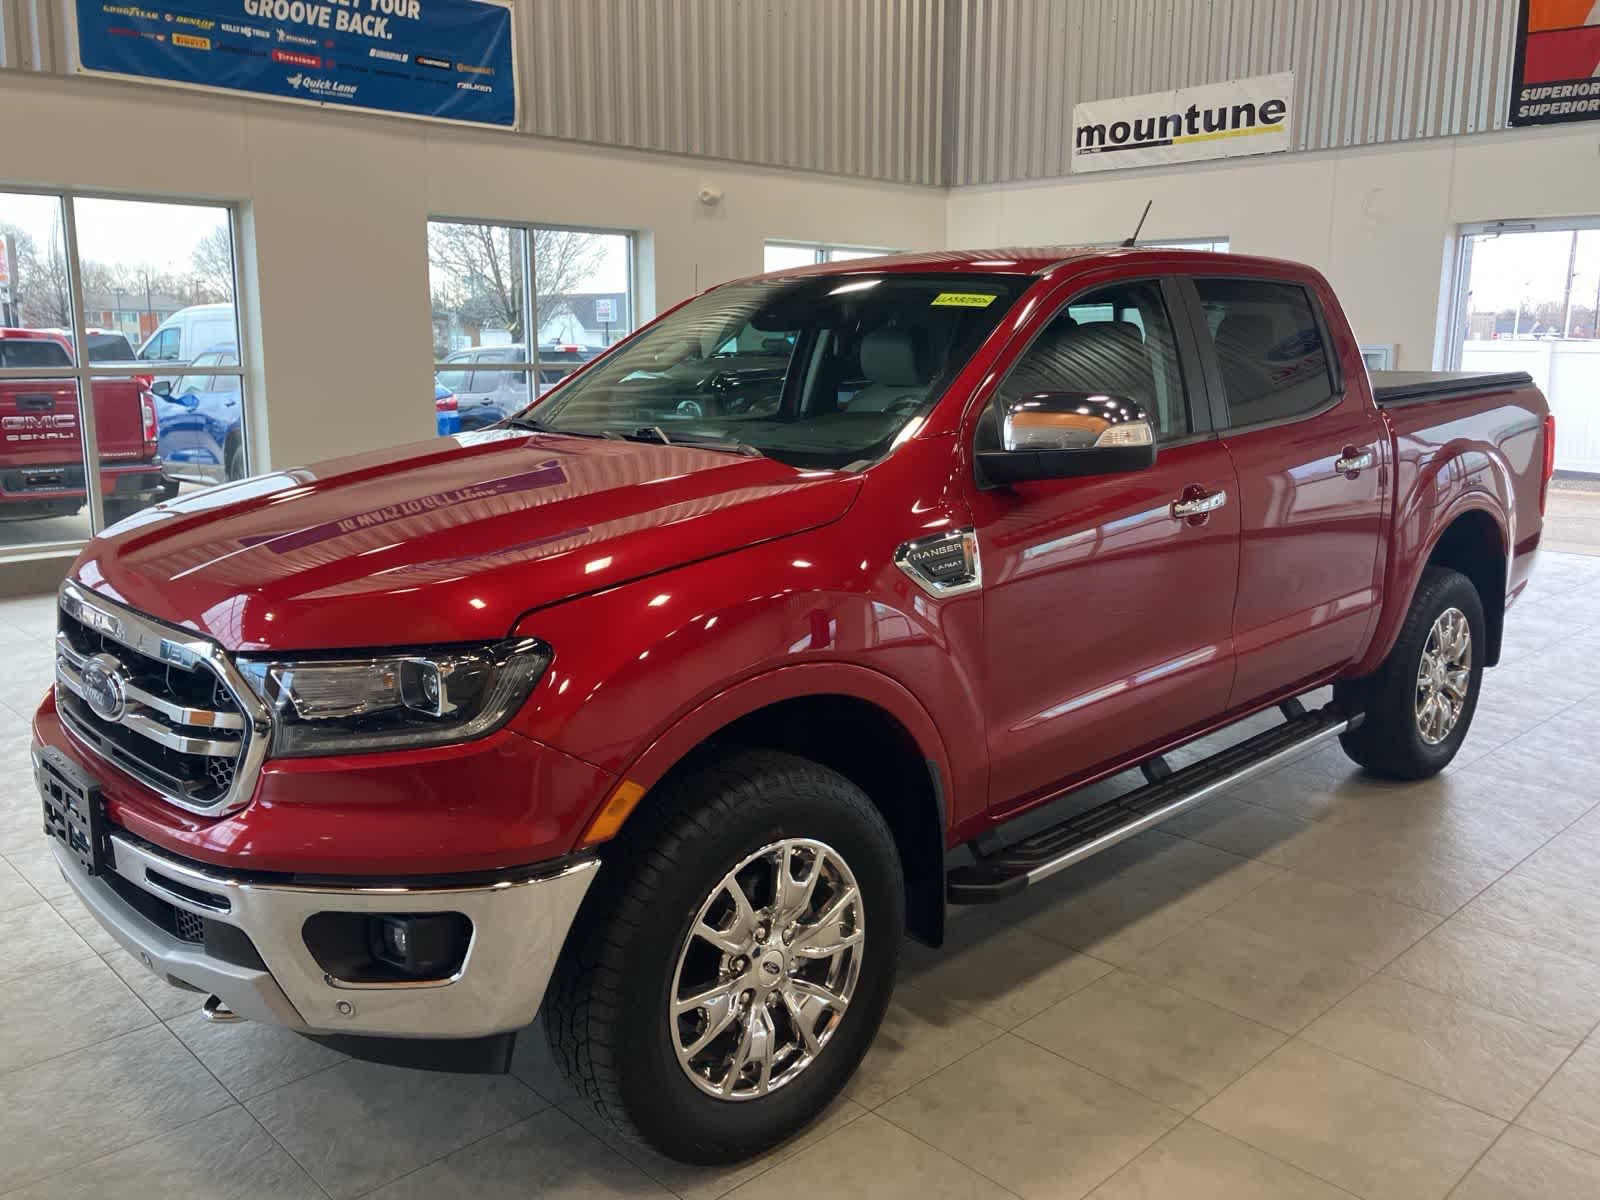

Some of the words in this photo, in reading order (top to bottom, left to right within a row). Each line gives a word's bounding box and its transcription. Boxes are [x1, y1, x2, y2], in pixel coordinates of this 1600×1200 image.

[244, 0, 332, 28] GROOVE
[336, 9, 392, 40] BACK.
[302, 76, 332, 90] Quick
[332, 80, 358, 93] Lane
[1520, 82, 1600, 101] SUPERIOR
[1518, 99, 1600, 117] SUPERIOR
[1076, 99, 1287, 148] mountune
[2, 414, 76, 430] GMC
